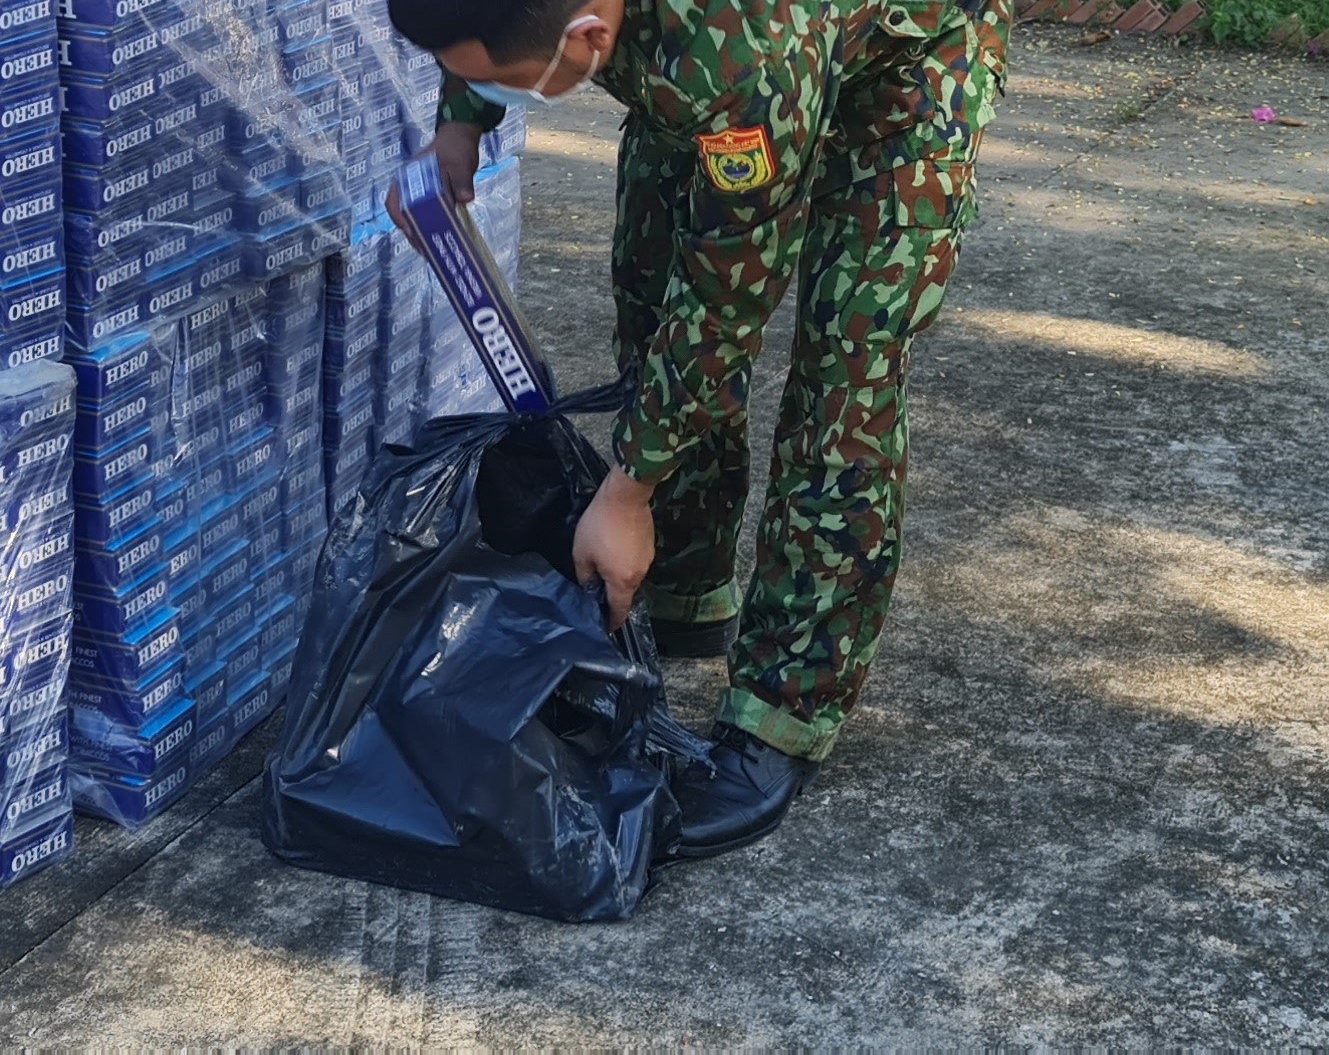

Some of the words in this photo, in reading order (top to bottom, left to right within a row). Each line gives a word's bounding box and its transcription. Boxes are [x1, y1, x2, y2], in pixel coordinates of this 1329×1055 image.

[8, 289, 61, 321] HERO
[106, 351, 148, 386] HERO
[472, 307, 536, 400] HERO
[124, 581, 165, 619] HERO
[145, 768, 186, 807] HERO
